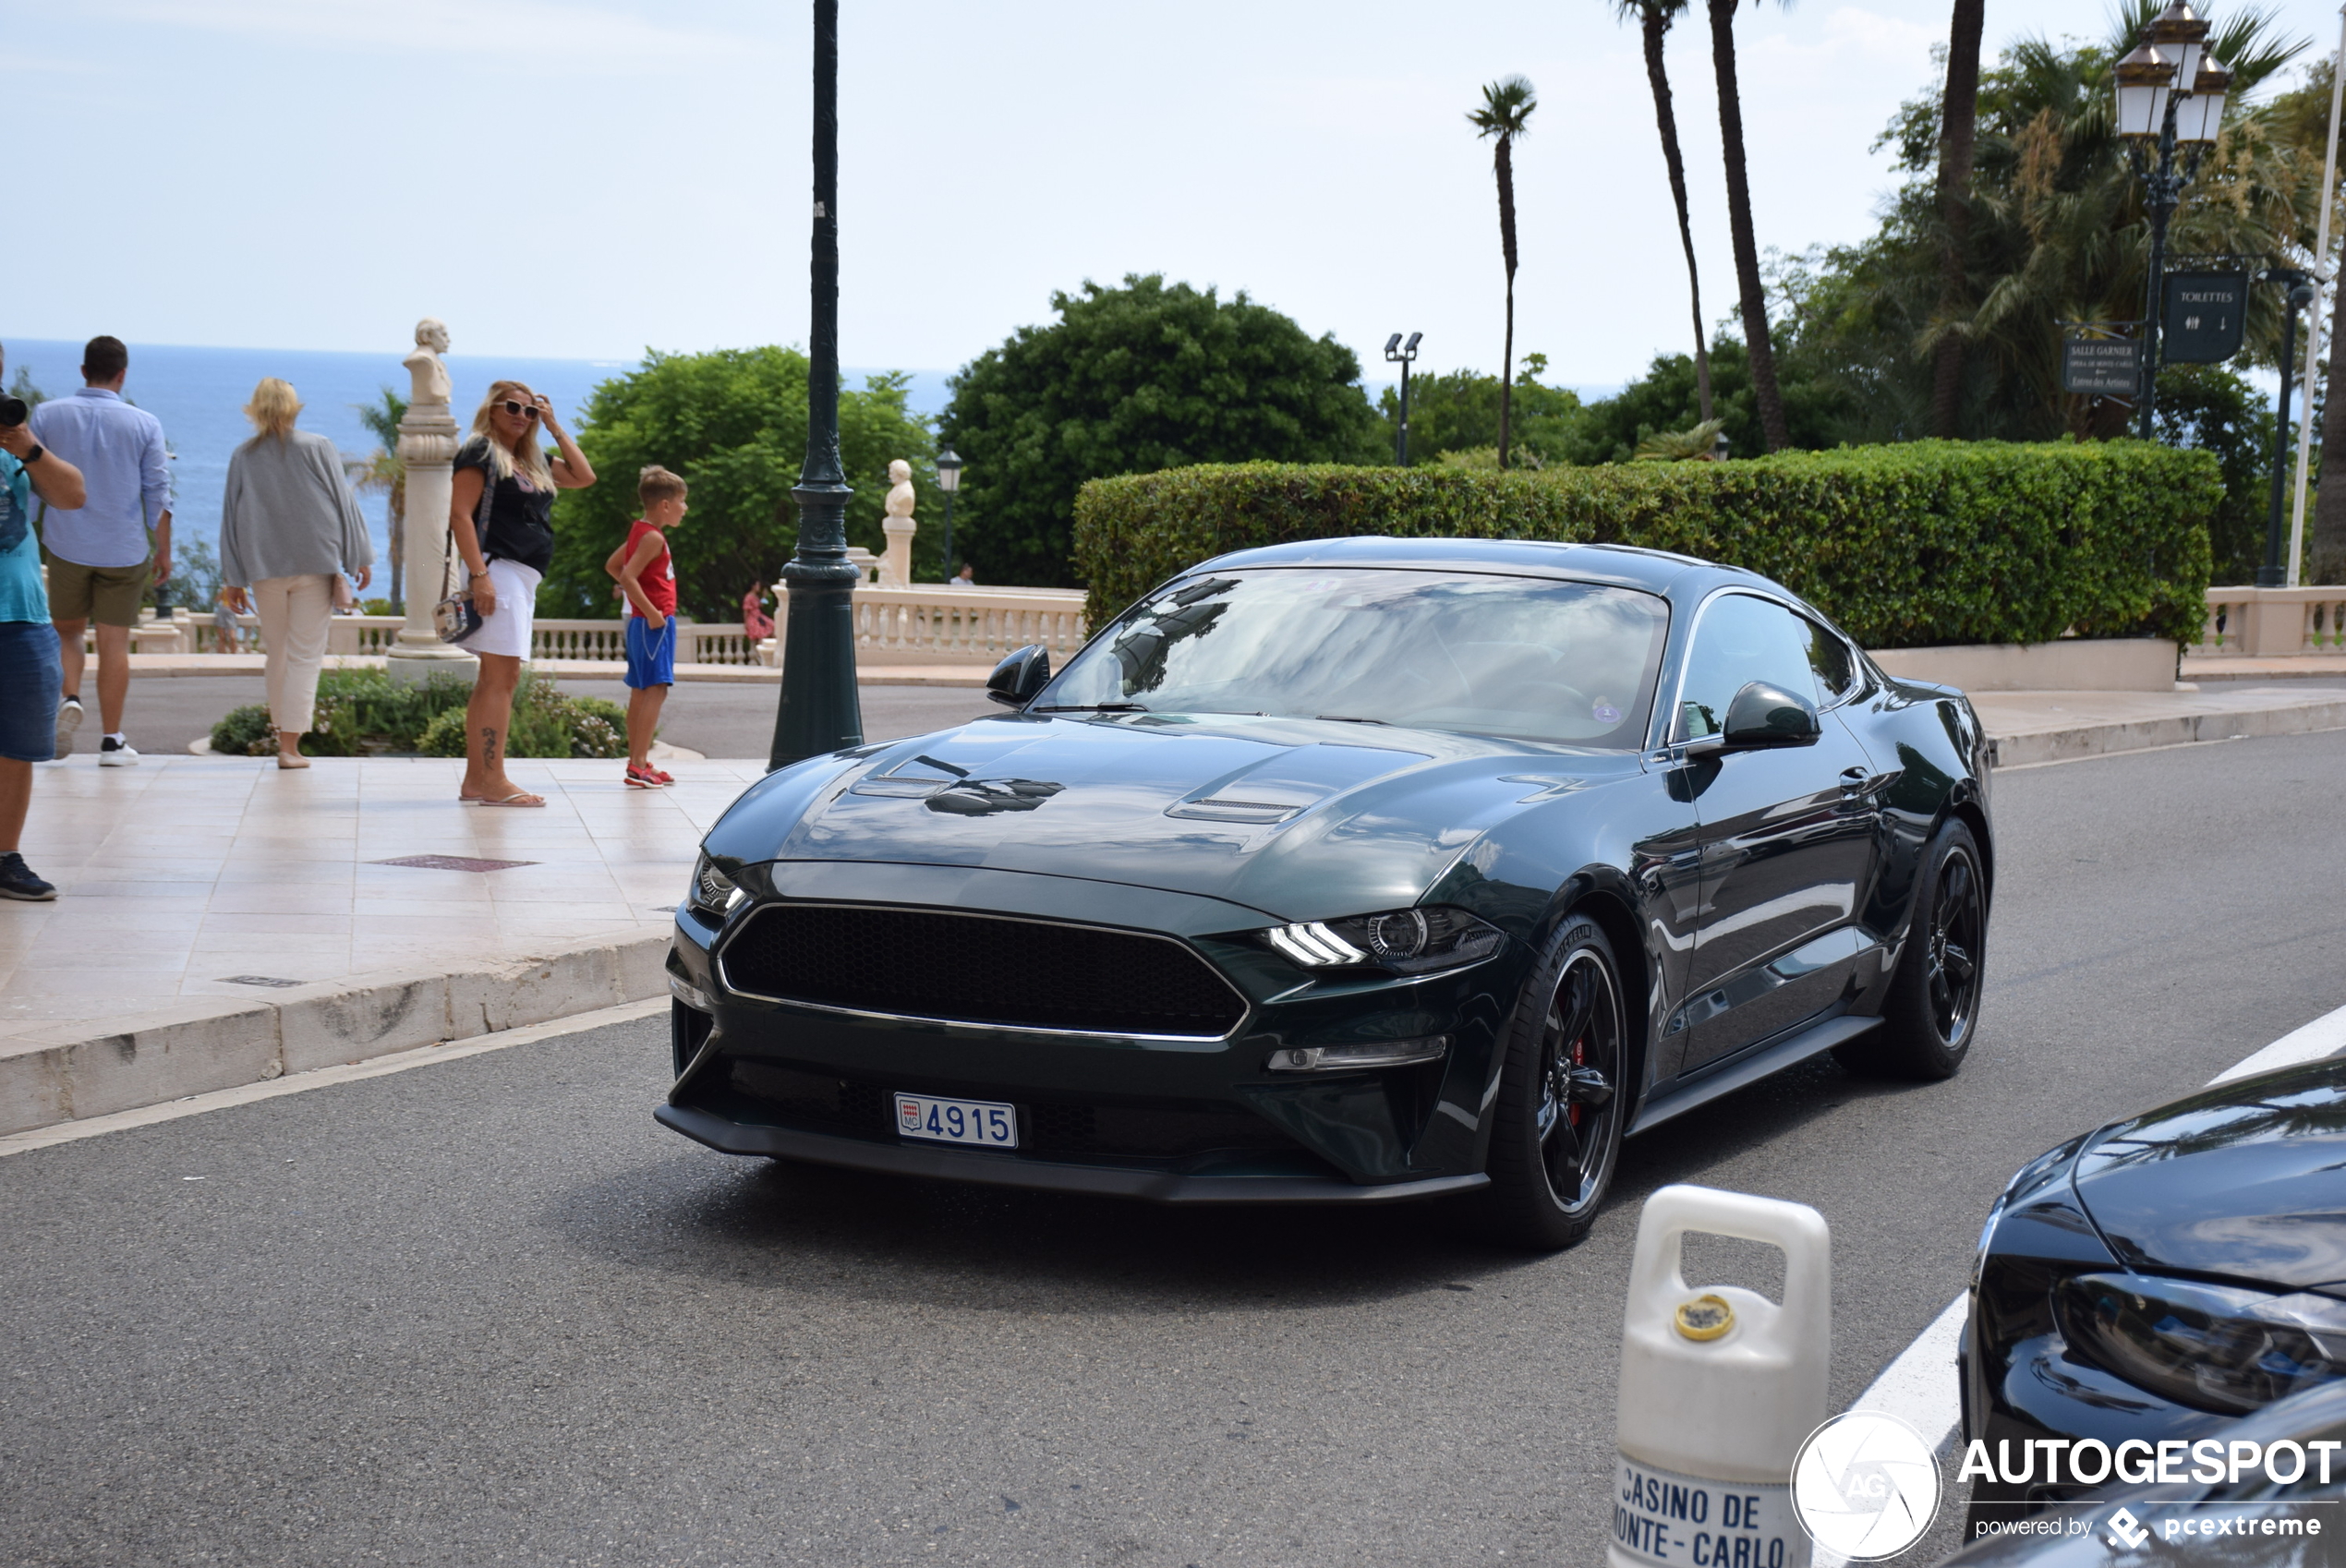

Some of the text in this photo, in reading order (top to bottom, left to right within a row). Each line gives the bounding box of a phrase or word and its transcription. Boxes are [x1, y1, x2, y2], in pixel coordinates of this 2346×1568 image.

[2181, 291, 2233, 303] TOILETTES
[2071, 344, 2133, 356] SALLE GARNIER
[2093, 376, 2104, 387] des
[2105, 377, 2131, 388] Artistes
[1602, 708, 1612, 717] 1
[1554, 925, 1591, 967] MICHELIN
[904, 1116, 919, 1127] MC
[926, 1104, 1010, 1142] 4915
[1722, 1493, 1760, 1530] DE
